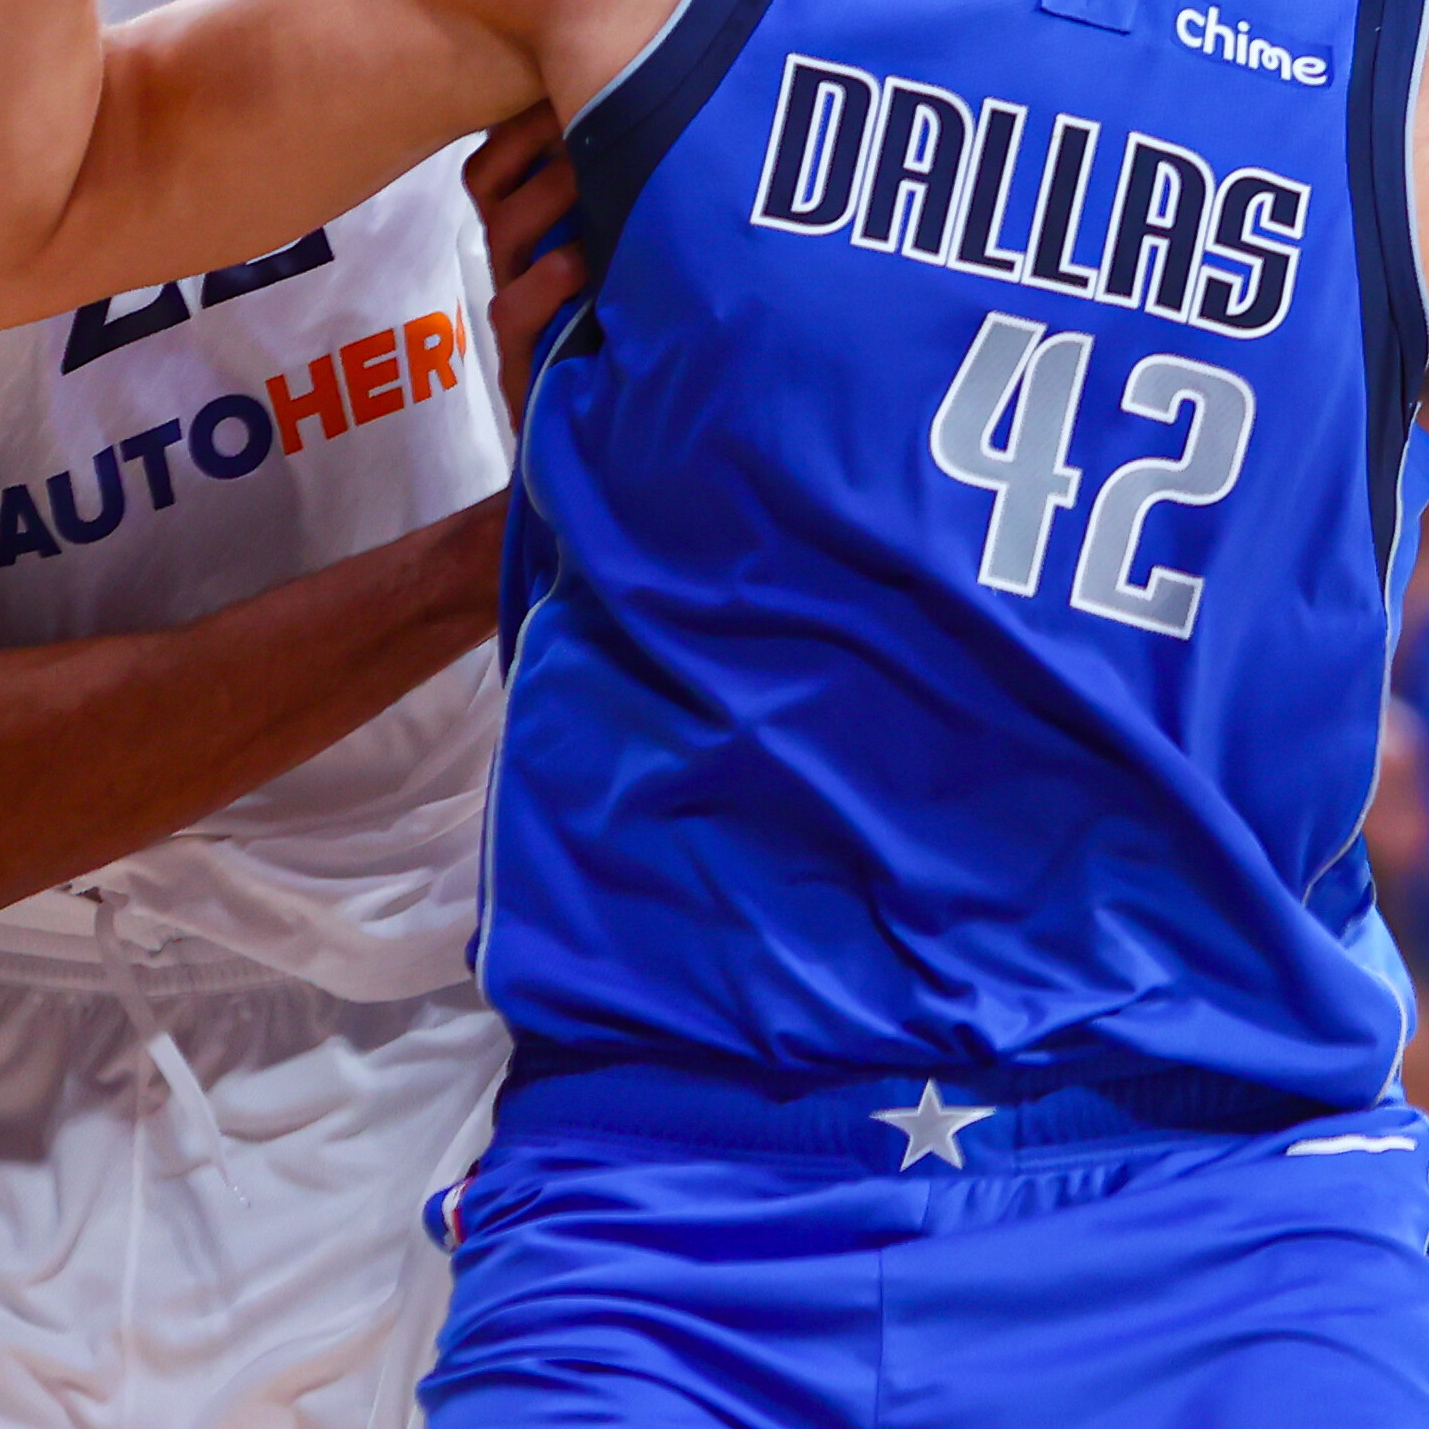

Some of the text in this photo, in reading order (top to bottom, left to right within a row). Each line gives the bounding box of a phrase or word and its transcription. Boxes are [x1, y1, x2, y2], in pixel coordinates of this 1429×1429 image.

[1175, 6, 1329, 87] chime
[750, 53, 1312, 340] DALLAS
[928, 309, 1256, 641] 42
